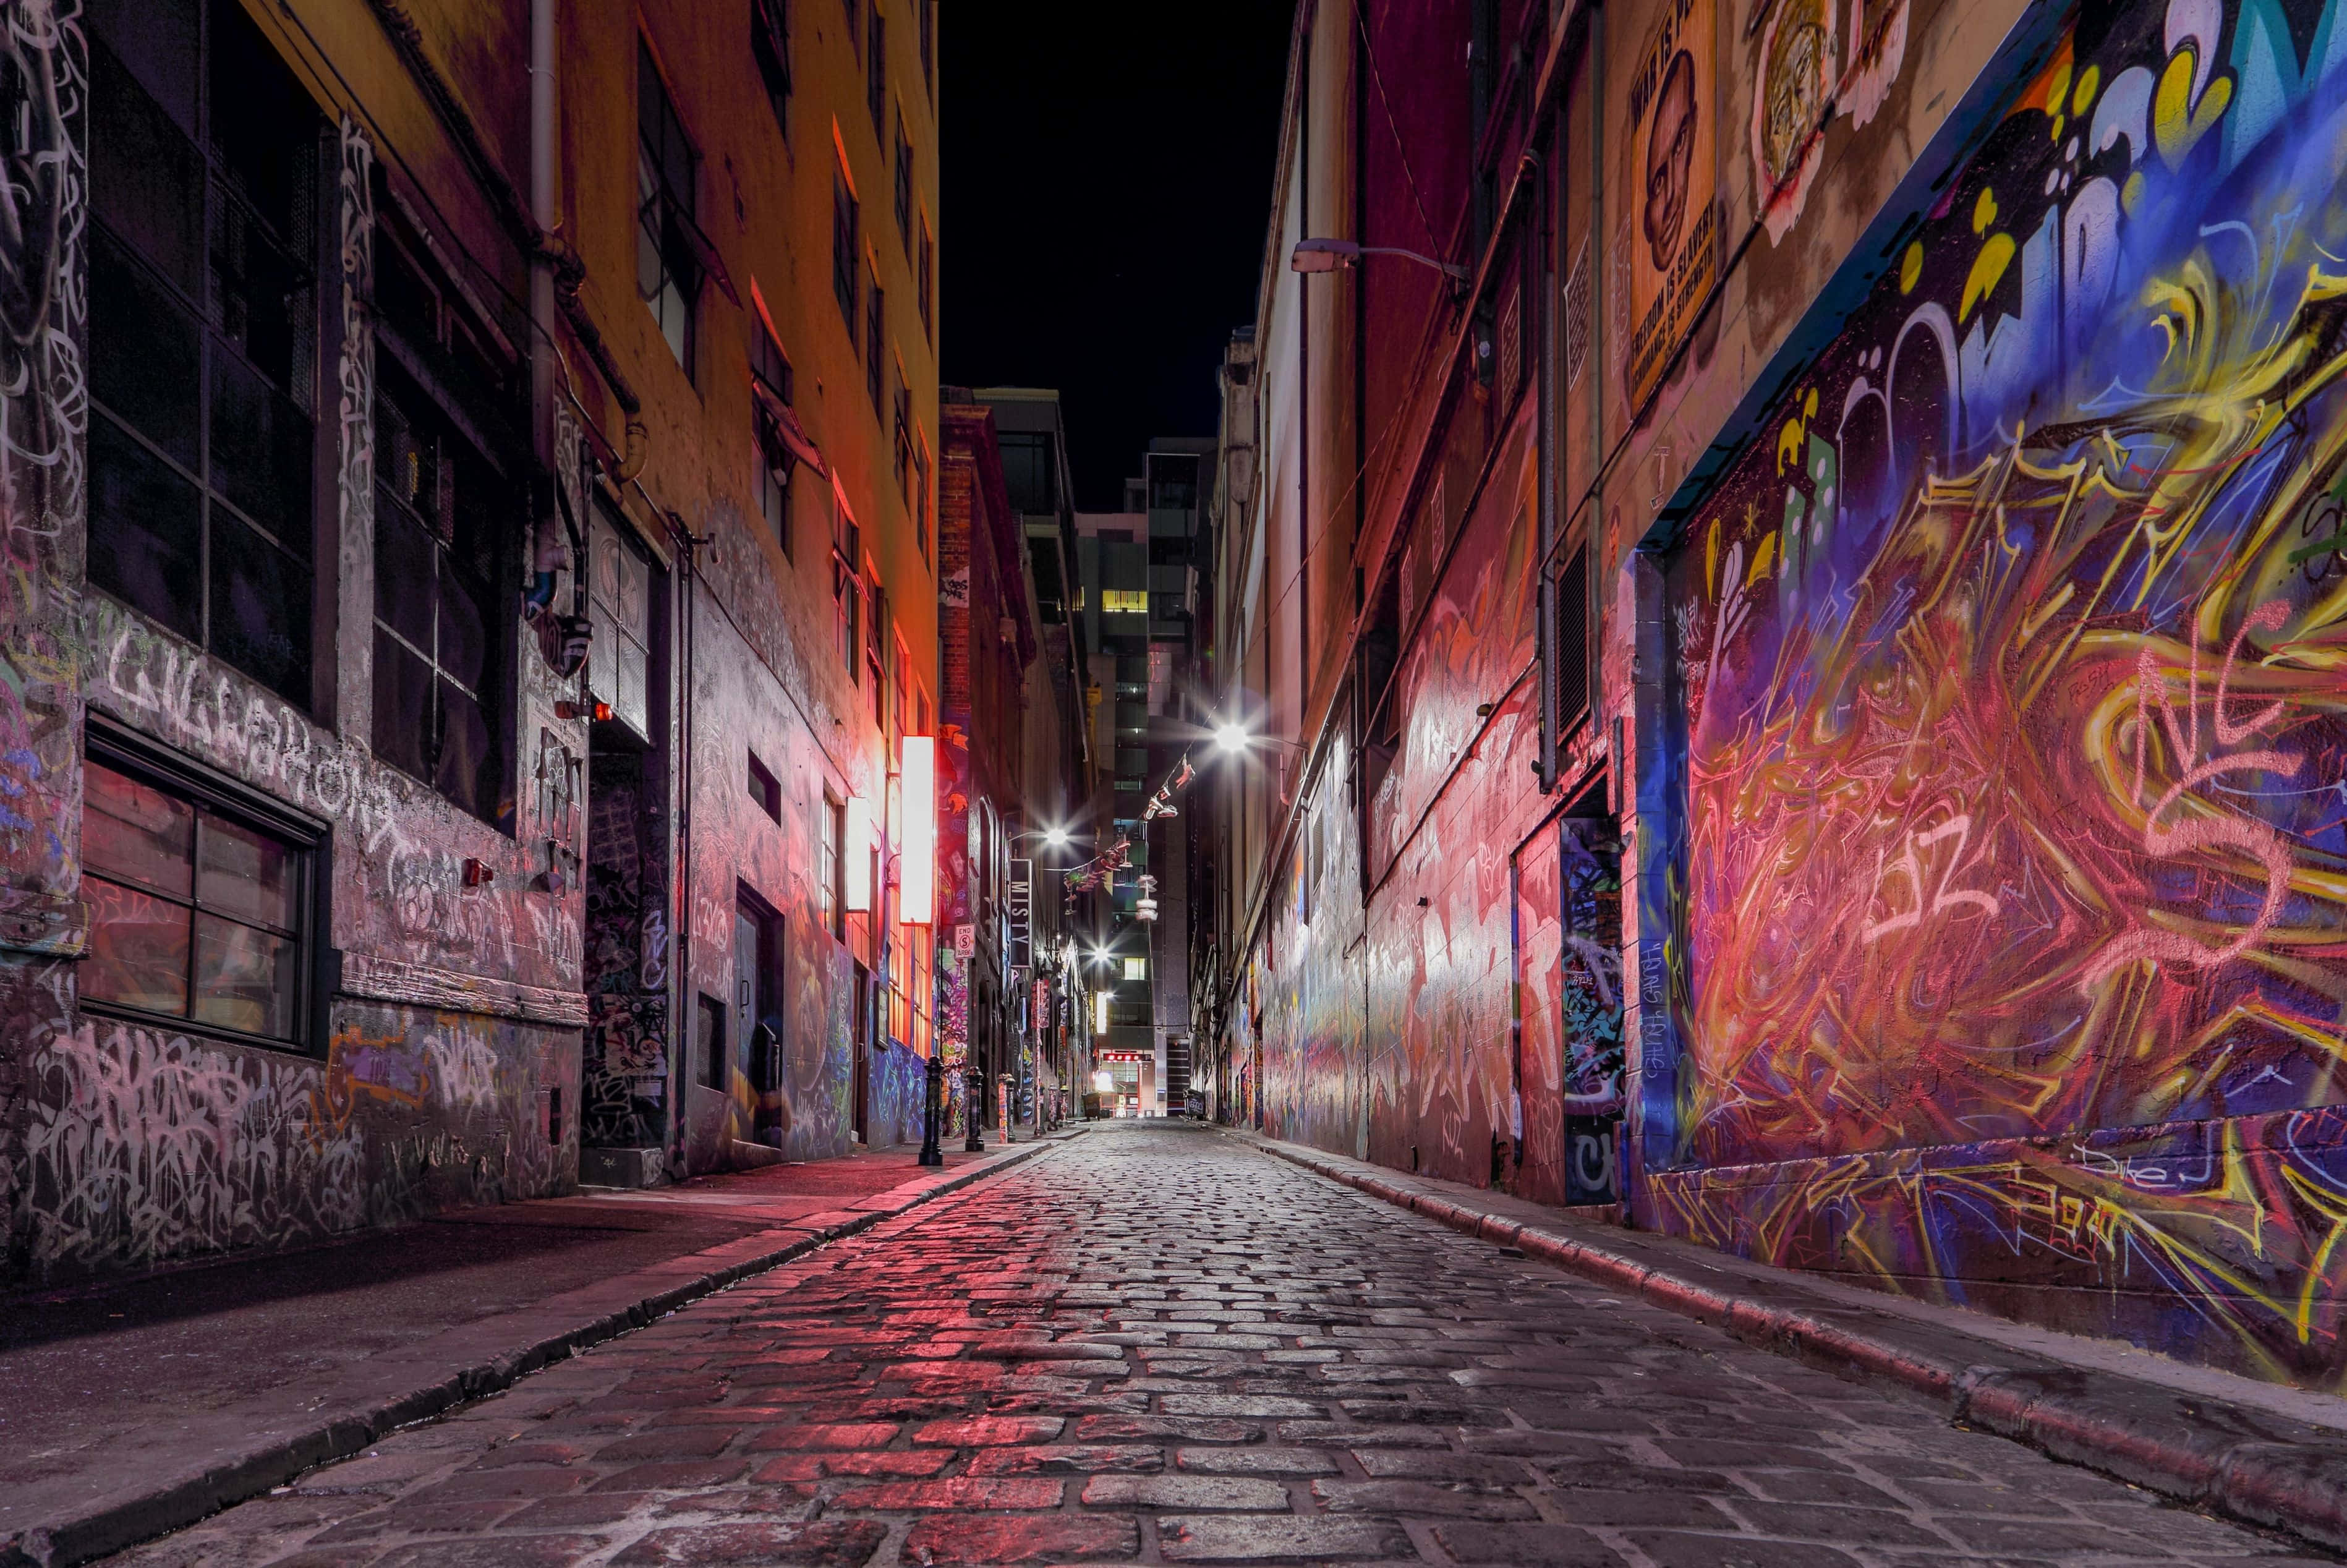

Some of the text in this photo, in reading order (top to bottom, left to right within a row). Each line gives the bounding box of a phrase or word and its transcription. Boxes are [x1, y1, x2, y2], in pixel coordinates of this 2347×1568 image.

[1631, 16, 1672, 134] WAR IS
[1632, 286, 1664, 361] FREEDOM
[1667, 266, 1675, 307] IS
[1677, 192, 1714, 286] SLAVERY
[1668, 305, 1675, 338] IS
[1677, 237, 1713, 322] STRENGTH
[1012, 881, 1028, 944] MISTY
